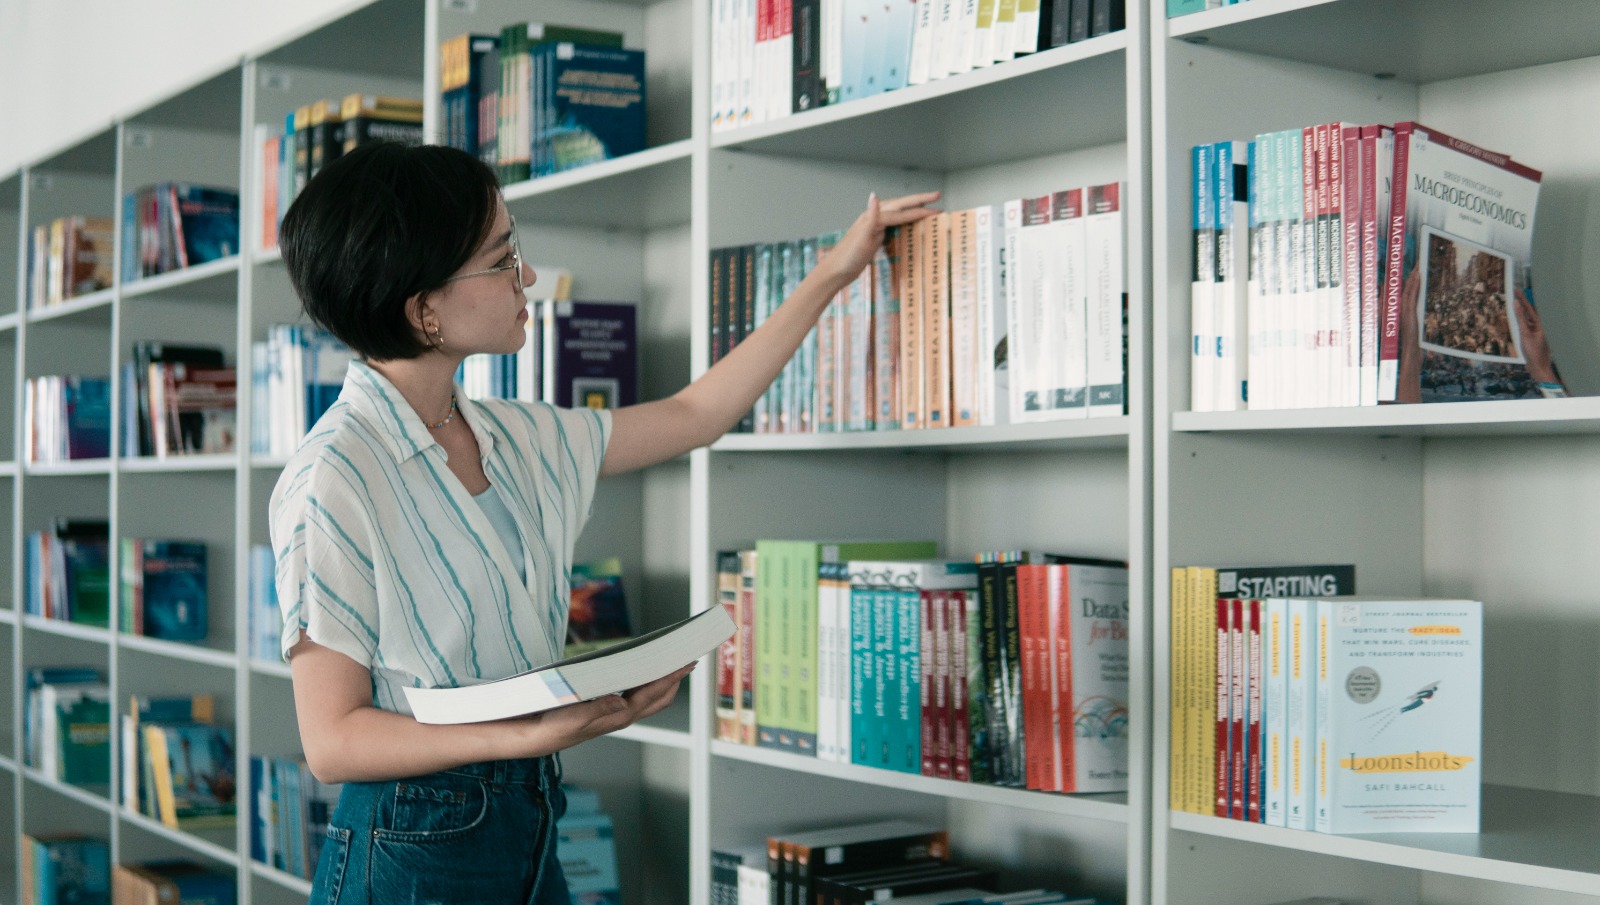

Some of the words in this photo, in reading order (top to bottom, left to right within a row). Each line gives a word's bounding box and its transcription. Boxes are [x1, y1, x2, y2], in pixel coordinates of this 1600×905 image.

[1304, 135, 1312, 166] MANKIW
[1318, 130, 1326, 162] MANKIW
[1331, 129, 1339, 161] MANKIW
[1198, 149, 1206, 180] MANKIW
[1218, 149, 1226, 179] MANKIW
[1304, 168, 1312, 184] AND
[1318, 163, 1326, 180] AND
[1331, 162, 1339, 179] AND
[1198, 181, 1206, 197] AND
[1218, 181, 1226, 197] AND
[1318, 181, 1326, 209] TAYLOR
[1331, 180, 1339, 208] TAYLOR
[1443, 170, 1461, 183] BRIEF
[1461, 177, 1495, 195] PRINCIPLES
[1495, 190, 1504, 198] OF
[1198, 198, 1206, 224] TAYLOR
[1218, 198, 1226, 225] TAYLOR
[1304, 185, 1312, 213] TAYLOR
[1414, 173, 1527, 230] MACROECONOMICS
[1198, 234, 1206, 275] ECONOMICS
[1218, 234, 1226, 276] ECONOMICS
[1318, 220, 1327, 282] MICROECONOMICS
[1331, 219, 1340, 281] MICROECONOMICS
[1363, 221, 1374, 344] MACROECONOMICS
[1386, 216, 1403, 338] MACROECONOMICS
[908, 292, 914, 307] IN
[932, 289, 938, 304] IN
[1098, 391, 1111, 400] MK
[1237, 572, 1337, 598] STARTING
[983, 577, 994, 629] Learning
[1005, 576, 1016, 628] Learning
[1081, 597, 1120, 619] Data
[862, 594, 872, 649] Learning
[884, 595, 895, 651] Learning
[909, 597, 919, 653] Learning
[1009, 631, 1018, 658] Web
[863, 652, 872, 679] PHP
[886, 653, 895, 680] PHP
[910, 656, 919, 683] PHP
[852, 654, 863, 715] JavaScript
[874, 655, 885, 716] JavaScript
[899, 658, 909, 720] JavaScript
[1350, 750, 1461, 771] Loonshots
[1365, 784, 1389, 792] SAFI
[1394, 783, 1446, 791] BAHCALL
